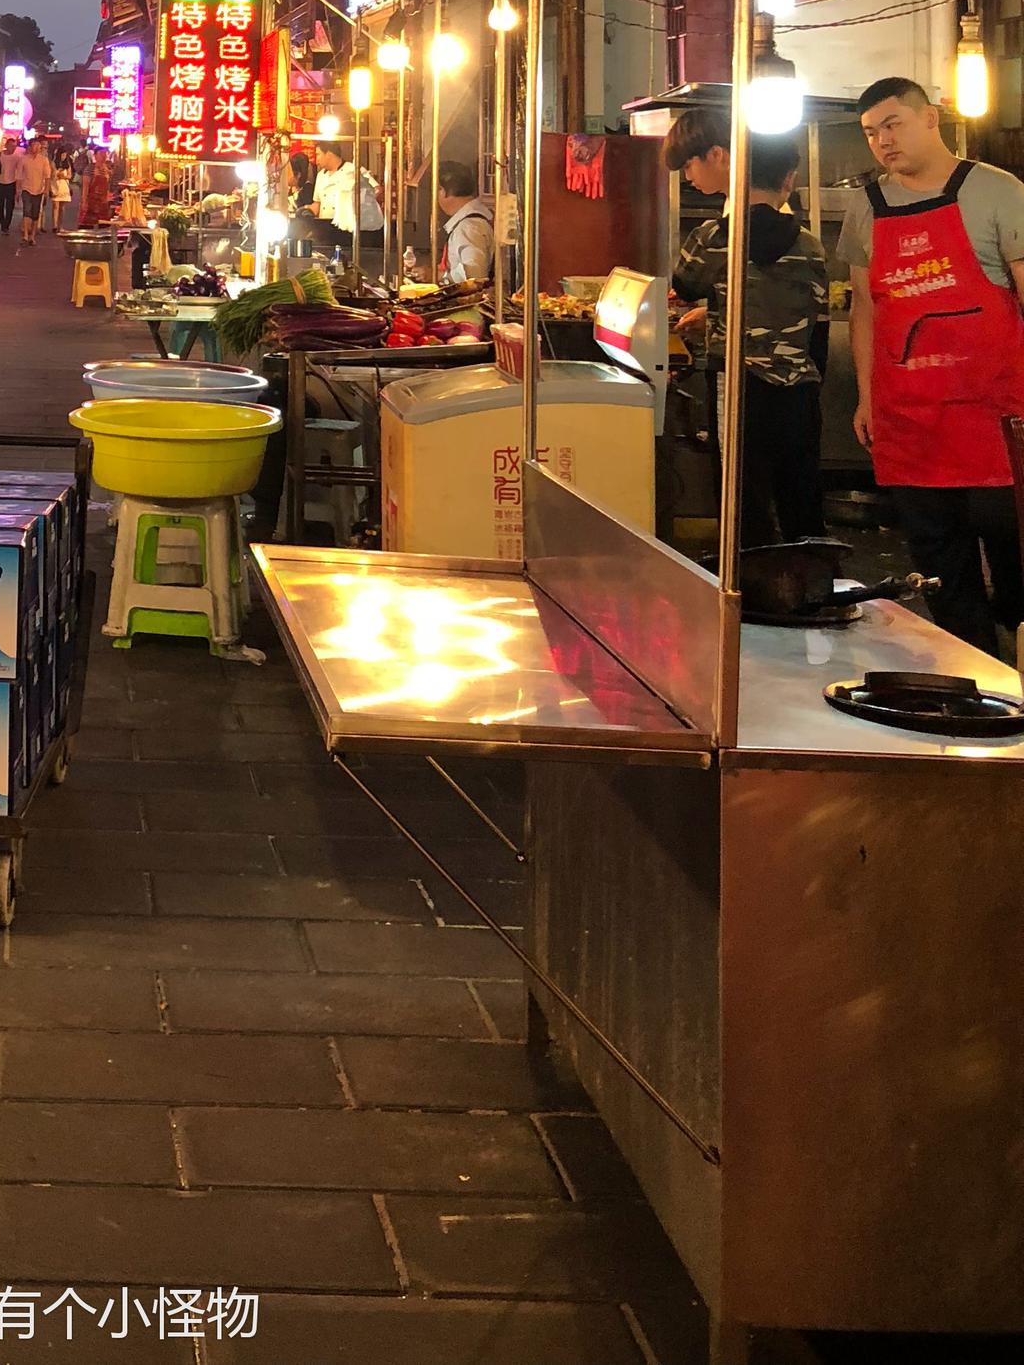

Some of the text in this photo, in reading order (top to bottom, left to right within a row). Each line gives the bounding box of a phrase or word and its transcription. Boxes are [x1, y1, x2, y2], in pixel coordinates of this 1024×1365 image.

[168, 1, 207, 152] 特色烤脑花
[213, 3, 252, 155] 特色烤米皮
